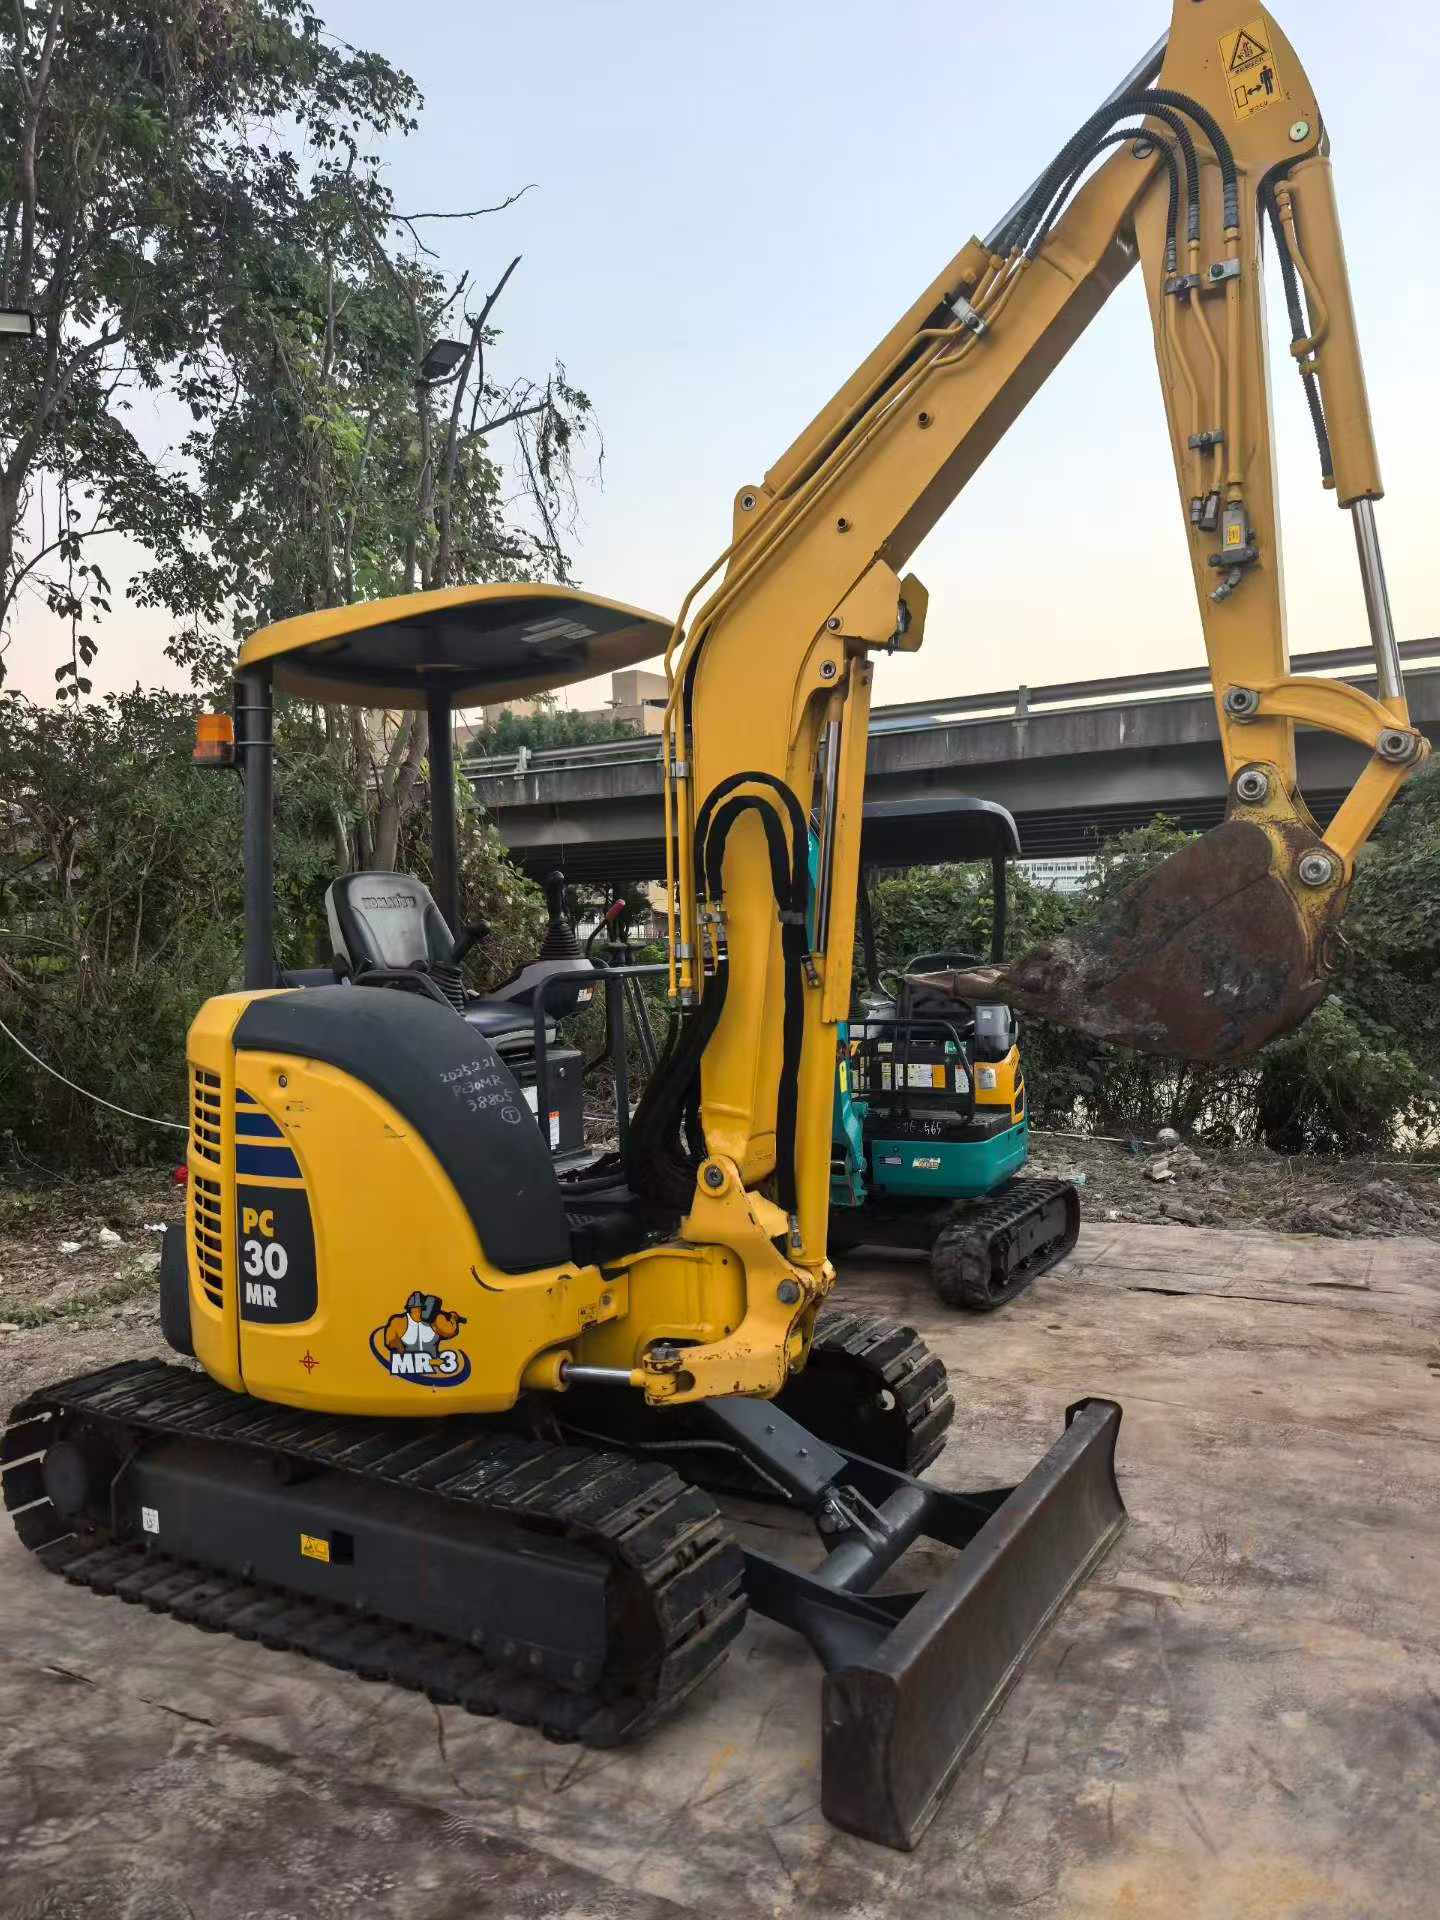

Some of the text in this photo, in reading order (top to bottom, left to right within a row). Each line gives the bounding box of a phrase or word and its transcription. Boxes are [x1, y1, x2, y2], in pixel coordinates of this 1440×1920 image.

[242, 1206, 274, 1238] PC
[243, 1239, 288, 1280] 30
[245, 1282, 278, 1308] MR
[391, 1350, 458, 1374] MR-3
